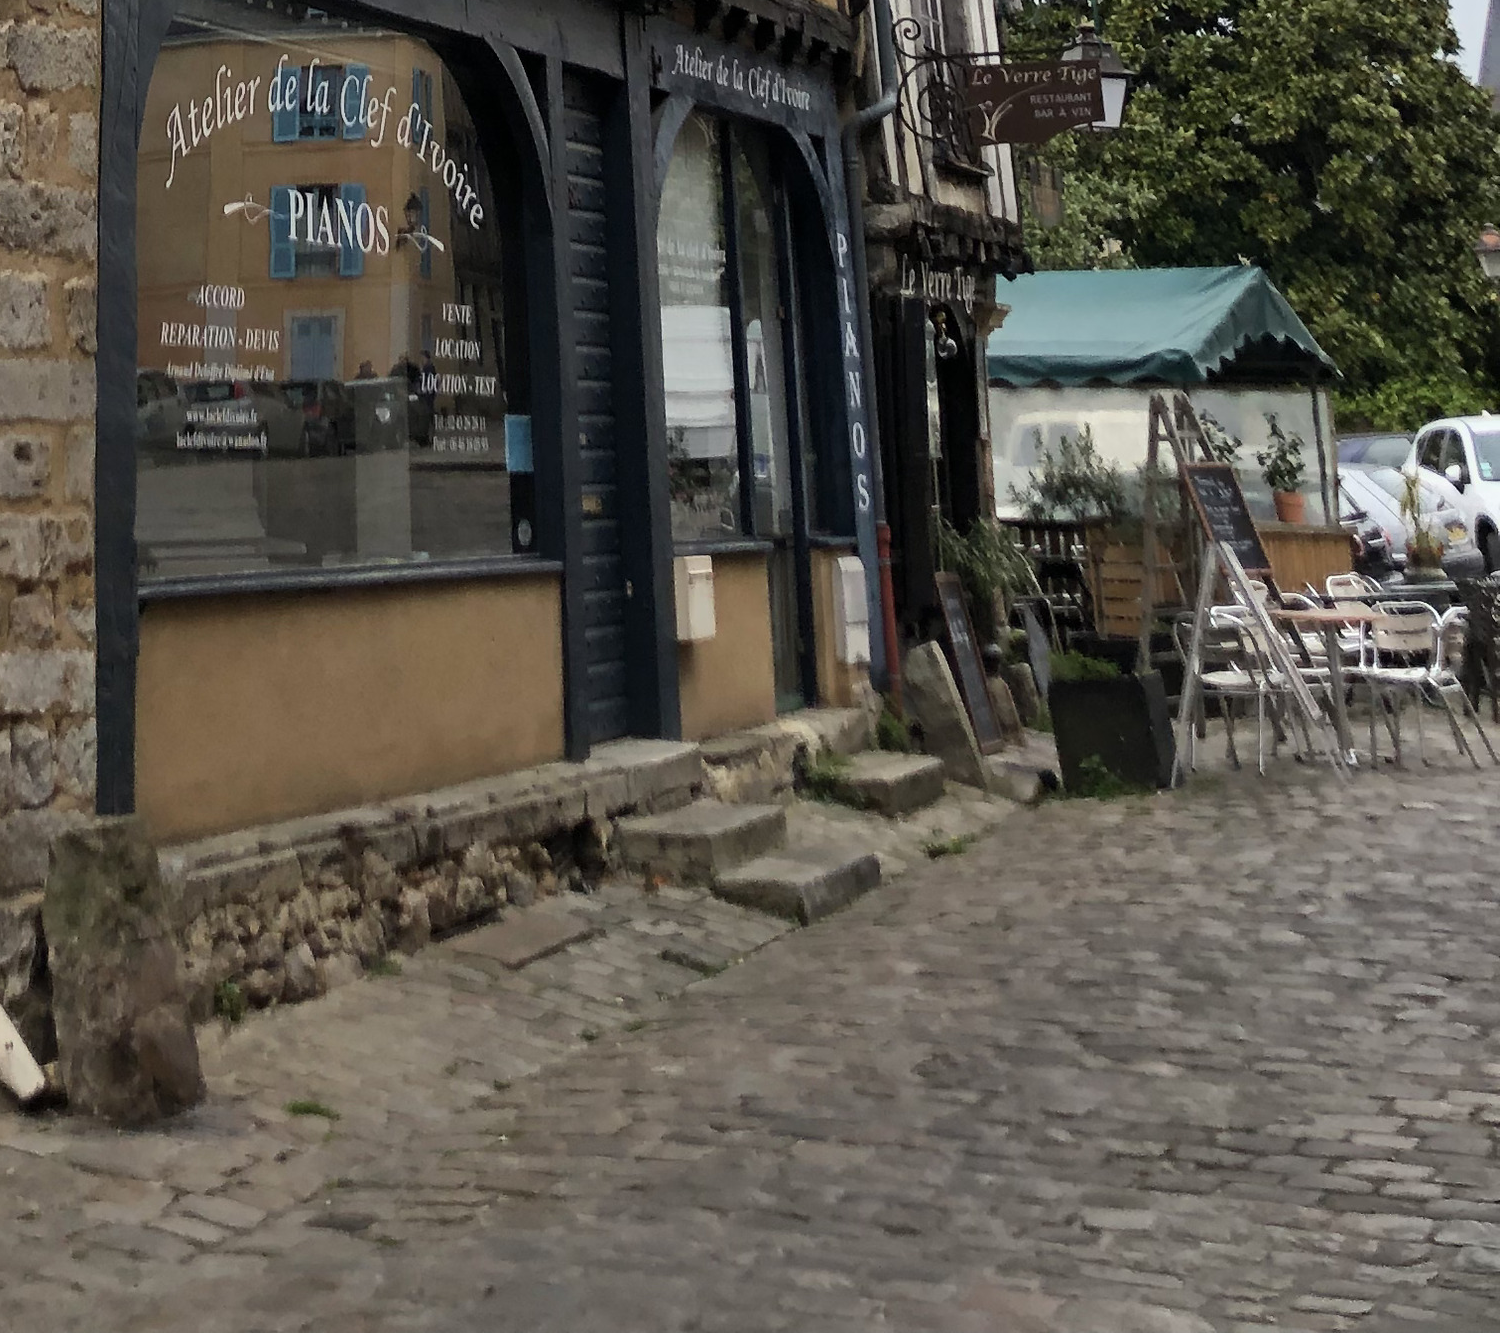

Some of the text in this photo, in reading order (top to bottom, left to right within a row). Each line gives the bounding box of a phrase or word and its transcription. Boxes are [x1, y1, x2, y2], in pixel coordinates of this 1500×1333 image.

[671, 44, 713, 81] Atelier
[716, 55, 729, 87] de
[733, 59, 744, 91] la
[748, 66, 772, 109] Clef
[972, 65, 1097, 86] Le Verre Tige
[1030, 92, 1092, 104] RESTAURANT
[1034, 108, 1054, 119] BAR
[1071, 107, 1092, 118] VIN
[165, 54, 484, 230] Atelier de la Clef d'Ivoire
[288, 189, 390, 256] PIANOS
[900, 253, 916, 296] Le
[921, 261, 951, 302] Verre
[196, 284, 245, 310] ACCORD
[442, 303, 472, 325] VENTE
[160, 321, 237, 349] REPARATION
[245, 328, 280, 352] DEVIS
[435, 338, 481, 361] LOCATION
[420, 373, 468, 394] LOCATION
[474, 376, 496, 397] TEST
[836, 232, 870, 512] PIANOS
